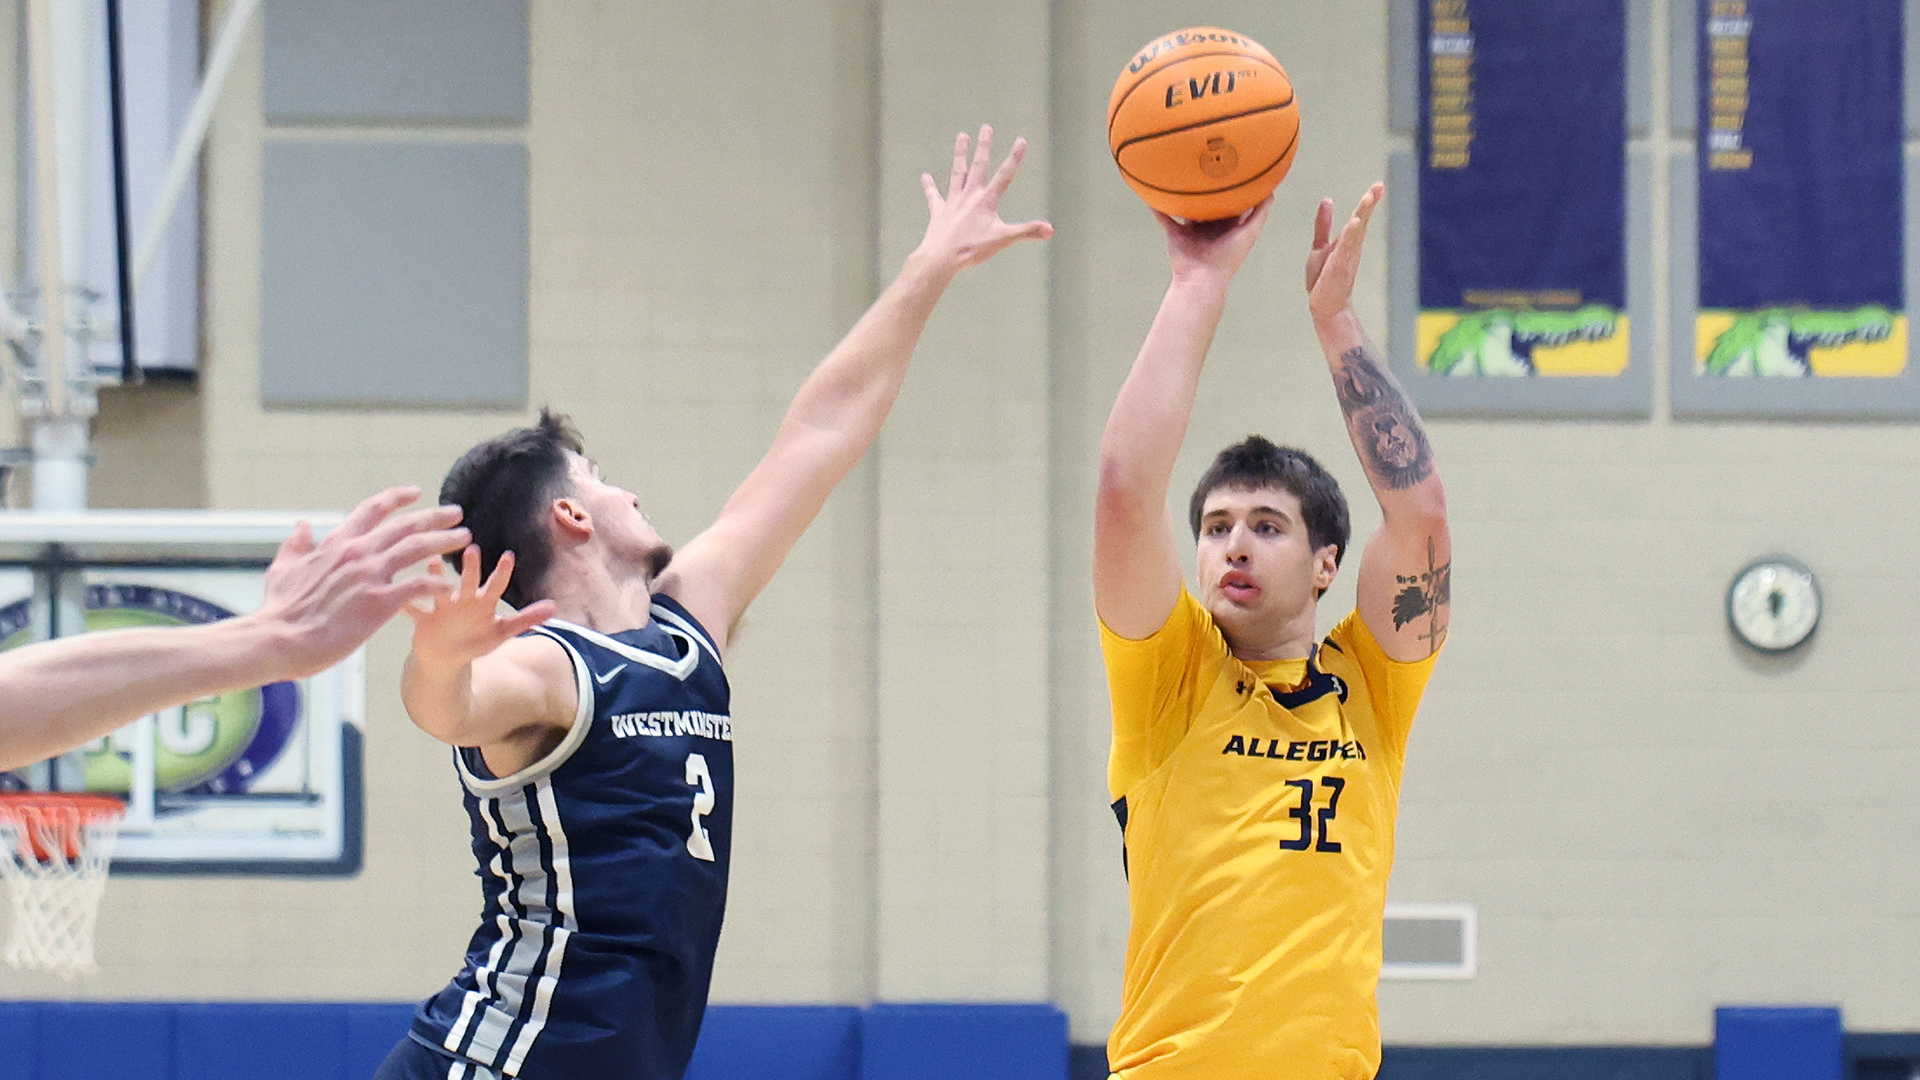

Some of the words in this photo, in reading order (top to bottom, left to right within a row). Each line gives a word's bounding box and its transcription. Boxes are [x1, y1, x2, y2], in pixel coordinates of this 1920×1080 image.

[1165, 71, 1236, 108] EVO
[611, 710, 732, 741] WESTMINSTE
[686, 753, 715, 862] 2
[1279, 776, 1345, 854] 32
